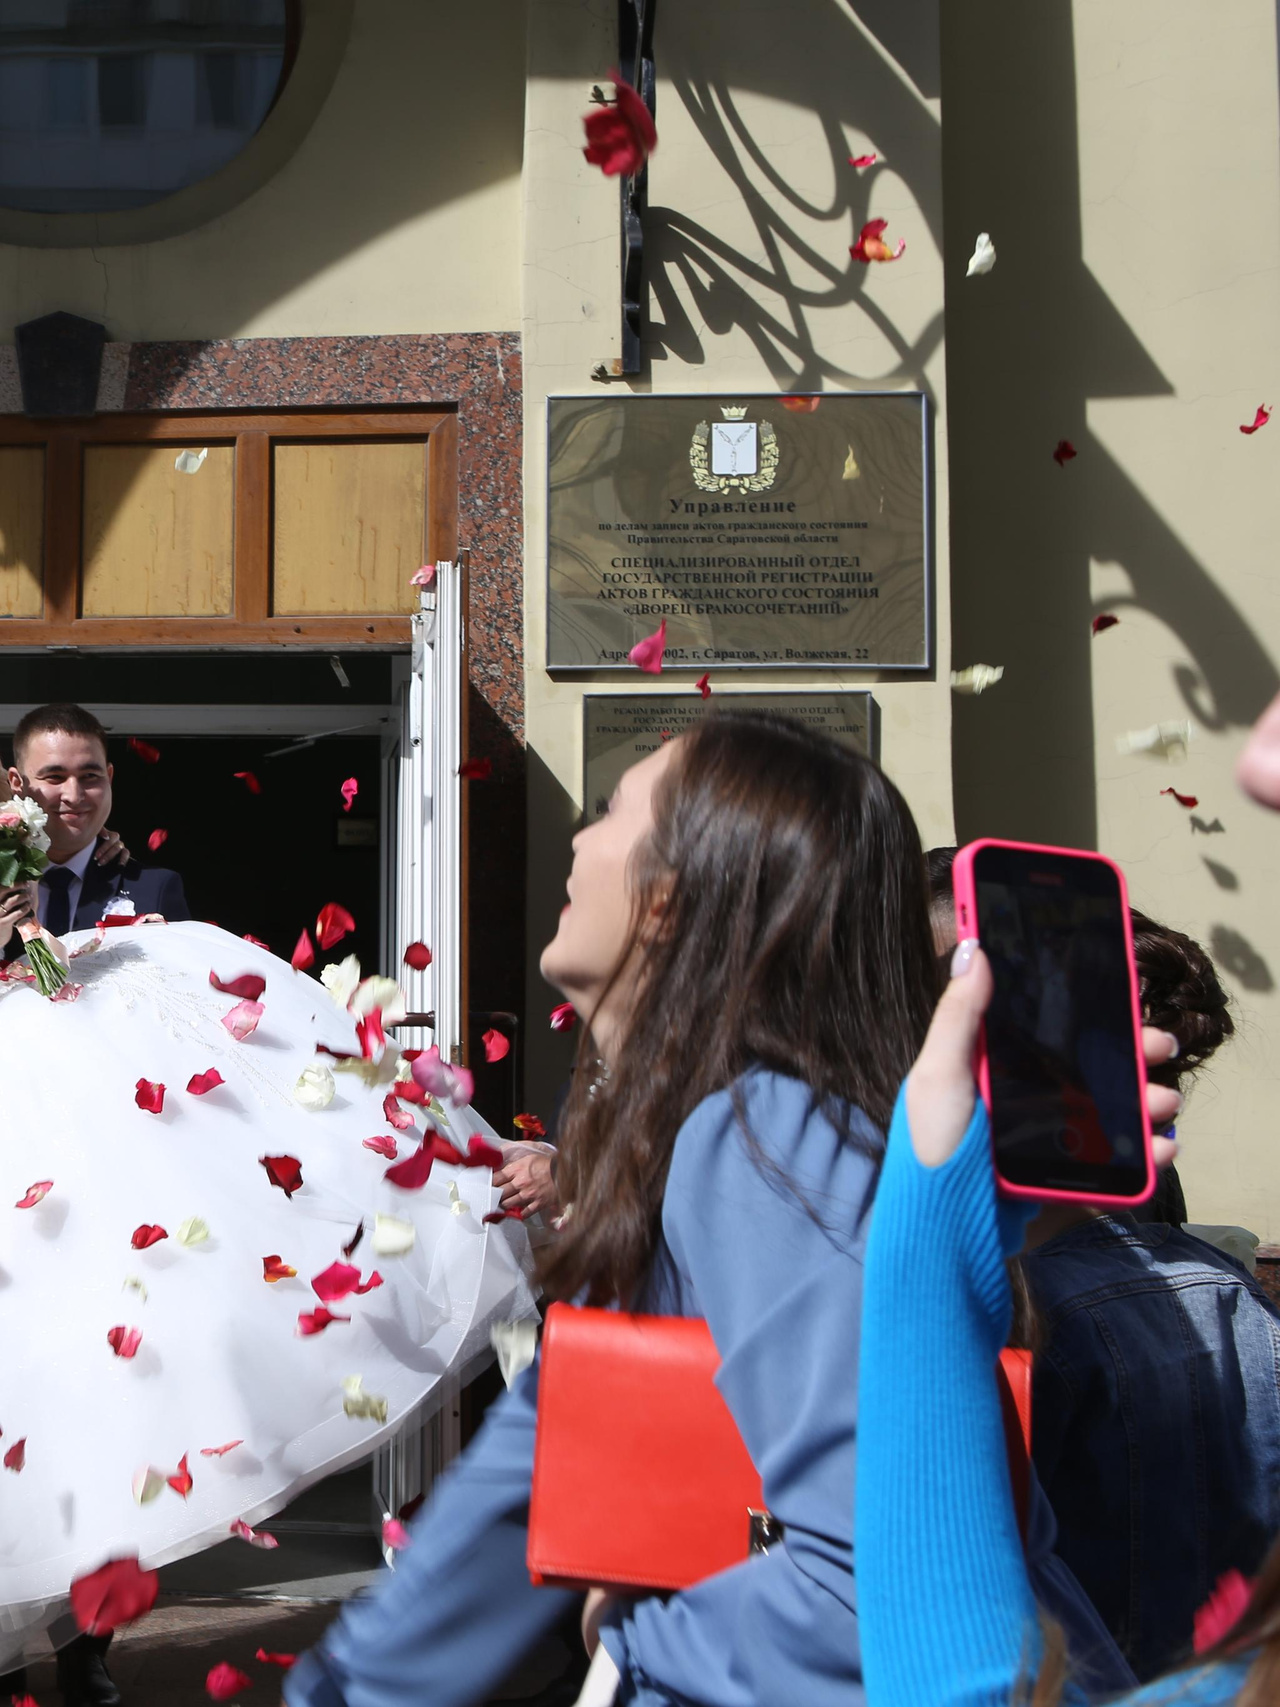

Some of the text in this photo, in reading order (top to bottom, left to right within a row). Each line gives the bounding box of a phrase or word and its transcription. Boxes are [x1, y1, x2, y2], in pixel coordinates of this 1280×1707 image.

[670, 498, 797, 516] Управление
[598, 520, 868, 532] по делам записи актов гражданского состояния
[627, 533, 839, 545] Правительства Саратовской области
[611, 556, 861, 570] СПЕЦИАЛИЗИРОВАННЫЙ ОТДЕЛ
[602, 570, 874, 585] ГОСУДАРСТВЕННОЙ РЕГИСТРАЦИИ
[597, 586, 879, 600] АКТОВ ГРАЖДАНСКОГО СОСТОЯНИЯ
[623, 601, 849, 616] «ДВОРЕЦ БРАКОСОЧЕТАНИЙ»
[703, 648, 760, 661] Саратов,
[785, 648, 852, 659] Волжская,
[855, 648, 869, 659] 22
[613, 707, 648, 715] РЕЖИМ
[650, 707, 686, 715] РАБОТЫ
[808, 706, 846, 715] ОТДЕЛА
[596, 725, 671, 734] ГРАЖДАНСКОГО
